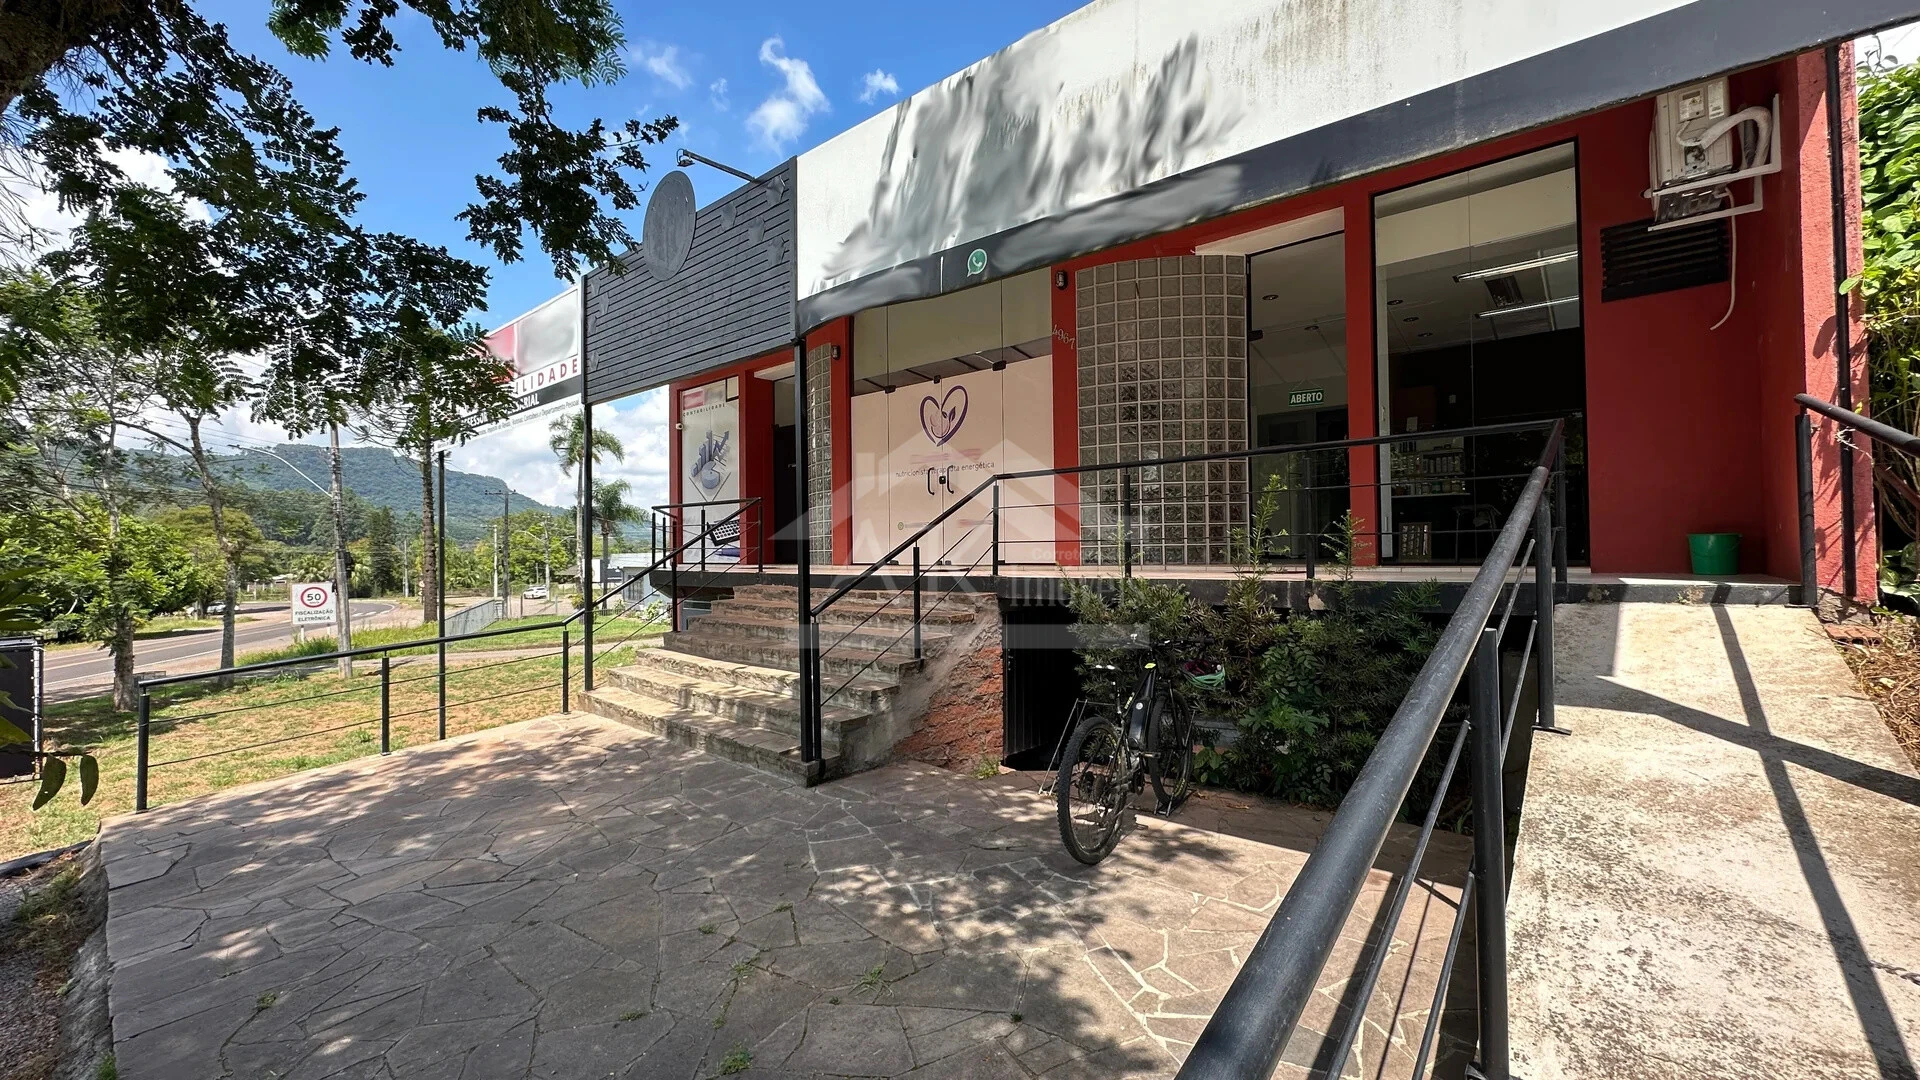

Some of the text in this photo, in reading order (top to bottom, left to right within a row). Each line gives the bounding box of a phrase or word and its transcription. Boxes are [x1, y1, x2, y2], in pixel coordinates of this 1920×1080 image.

[1052, 324, 1076, 350] 4967
[1290, 391, 1323, 404] ABERTO
[961, 460, 995, 472] energética
[307, 593, 321, 602] 50
